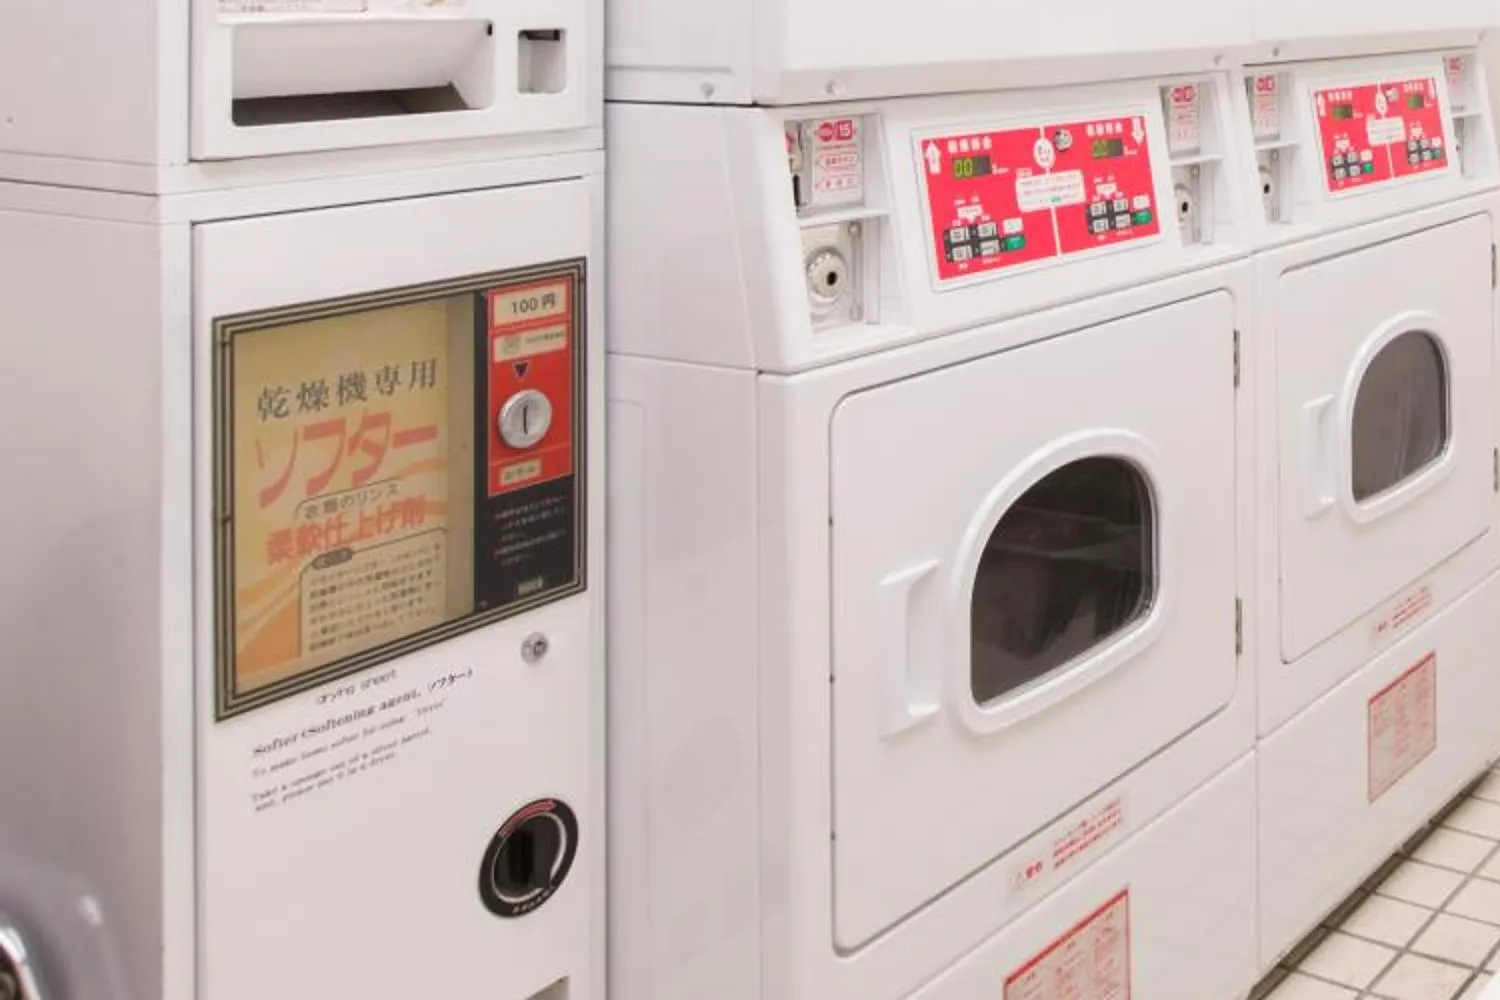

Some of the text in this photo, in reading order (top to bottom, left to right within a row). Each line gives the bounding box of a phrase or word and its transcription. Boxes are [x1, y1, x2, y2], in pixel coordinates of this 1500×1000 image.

[256, 357, 438, 422] 乾燥機専用
[255, 409, 438, 511] ソフター
[265, 495, 427, 565] 柔軟仕上げ剤
